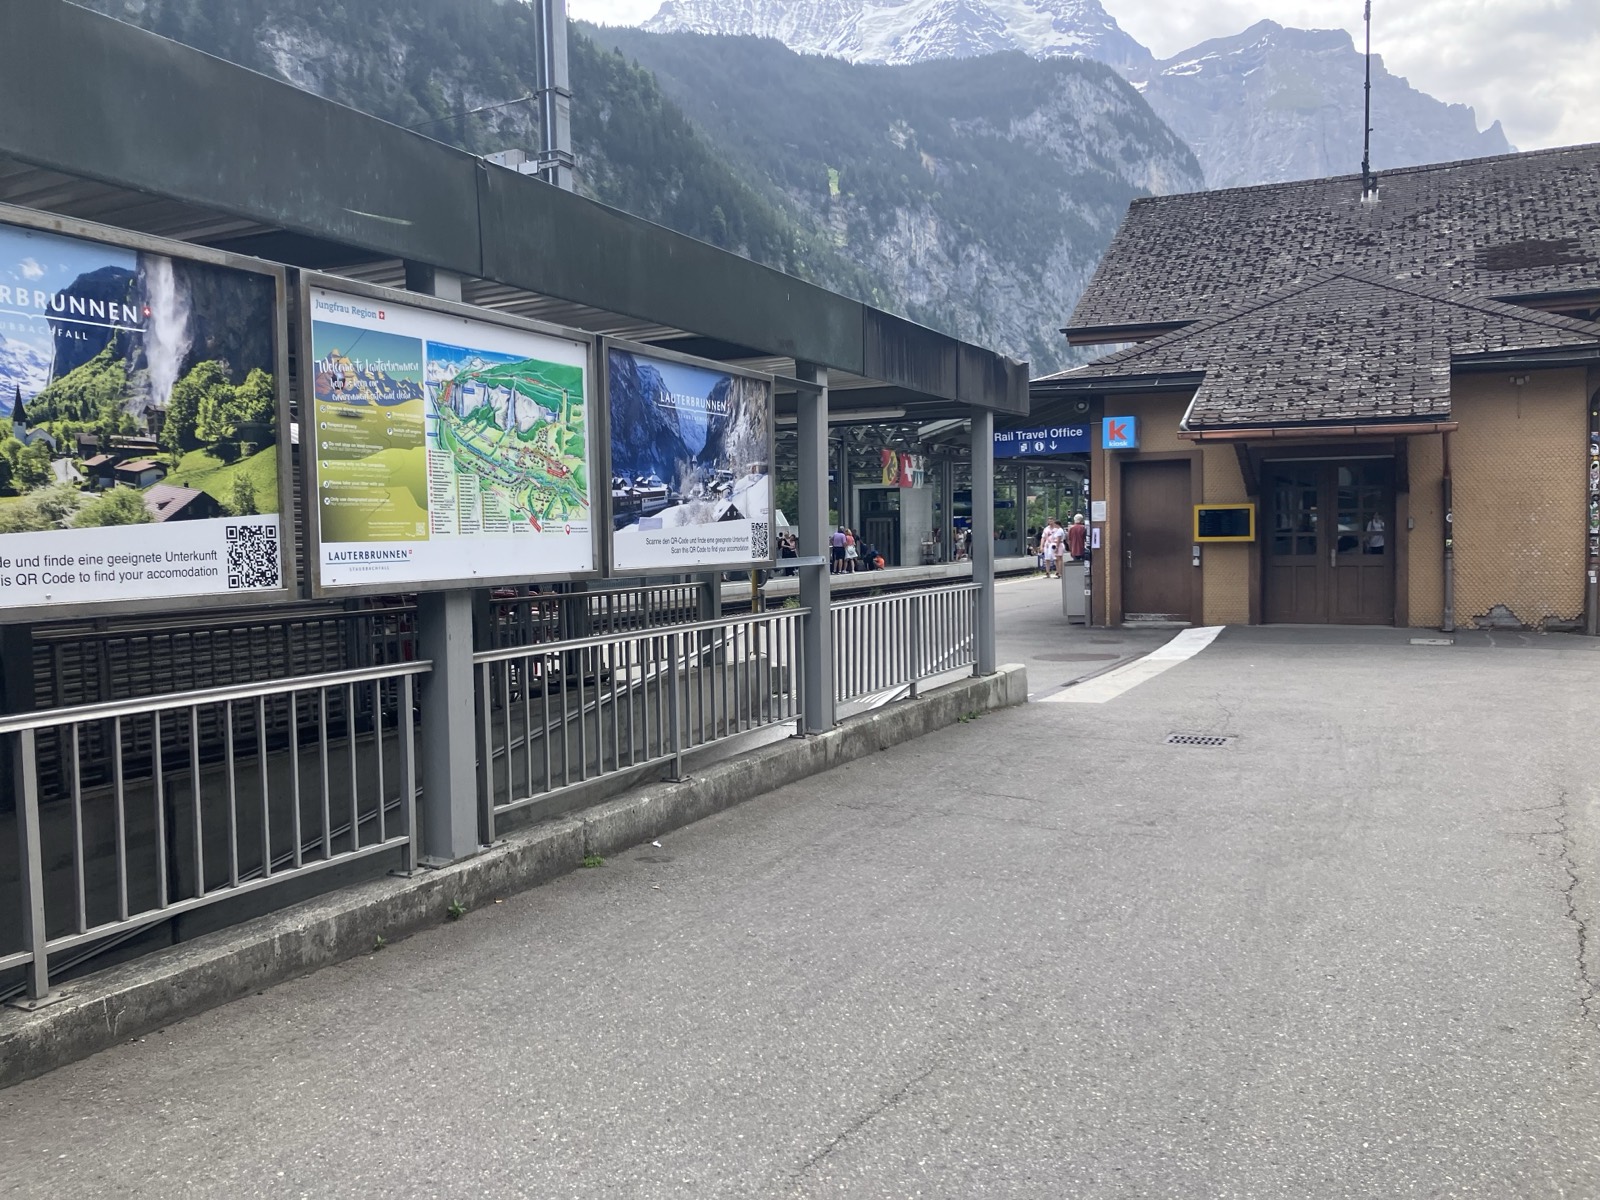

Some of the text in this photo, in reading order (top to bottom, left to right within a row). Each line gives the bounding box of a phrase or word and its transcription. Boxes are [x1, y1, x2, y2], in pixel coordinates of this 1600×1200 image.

[316, 299, 376, 318] Jungfrau Region
[314, 358, 352, 373] Welcome
[353, 358, 364, 372] to
[660, 391, 726, 412] LAUTERBRUNNEN
[994, 428, 1083, 442] Rail Travel Office
[0, 550, 218, 568] e und finde eine geeignete Unterkunft
[328, 550, 408, 561] LAUTERBRUNNEN
[16, 573, 38, 586] QR
[42, 572, 75, 584] Code
[79, 572, 90, 582] to
[94, 570, 116, 582] find
[119, 571, 144, 584] your
[146, 566, 218, 580] accomodation
